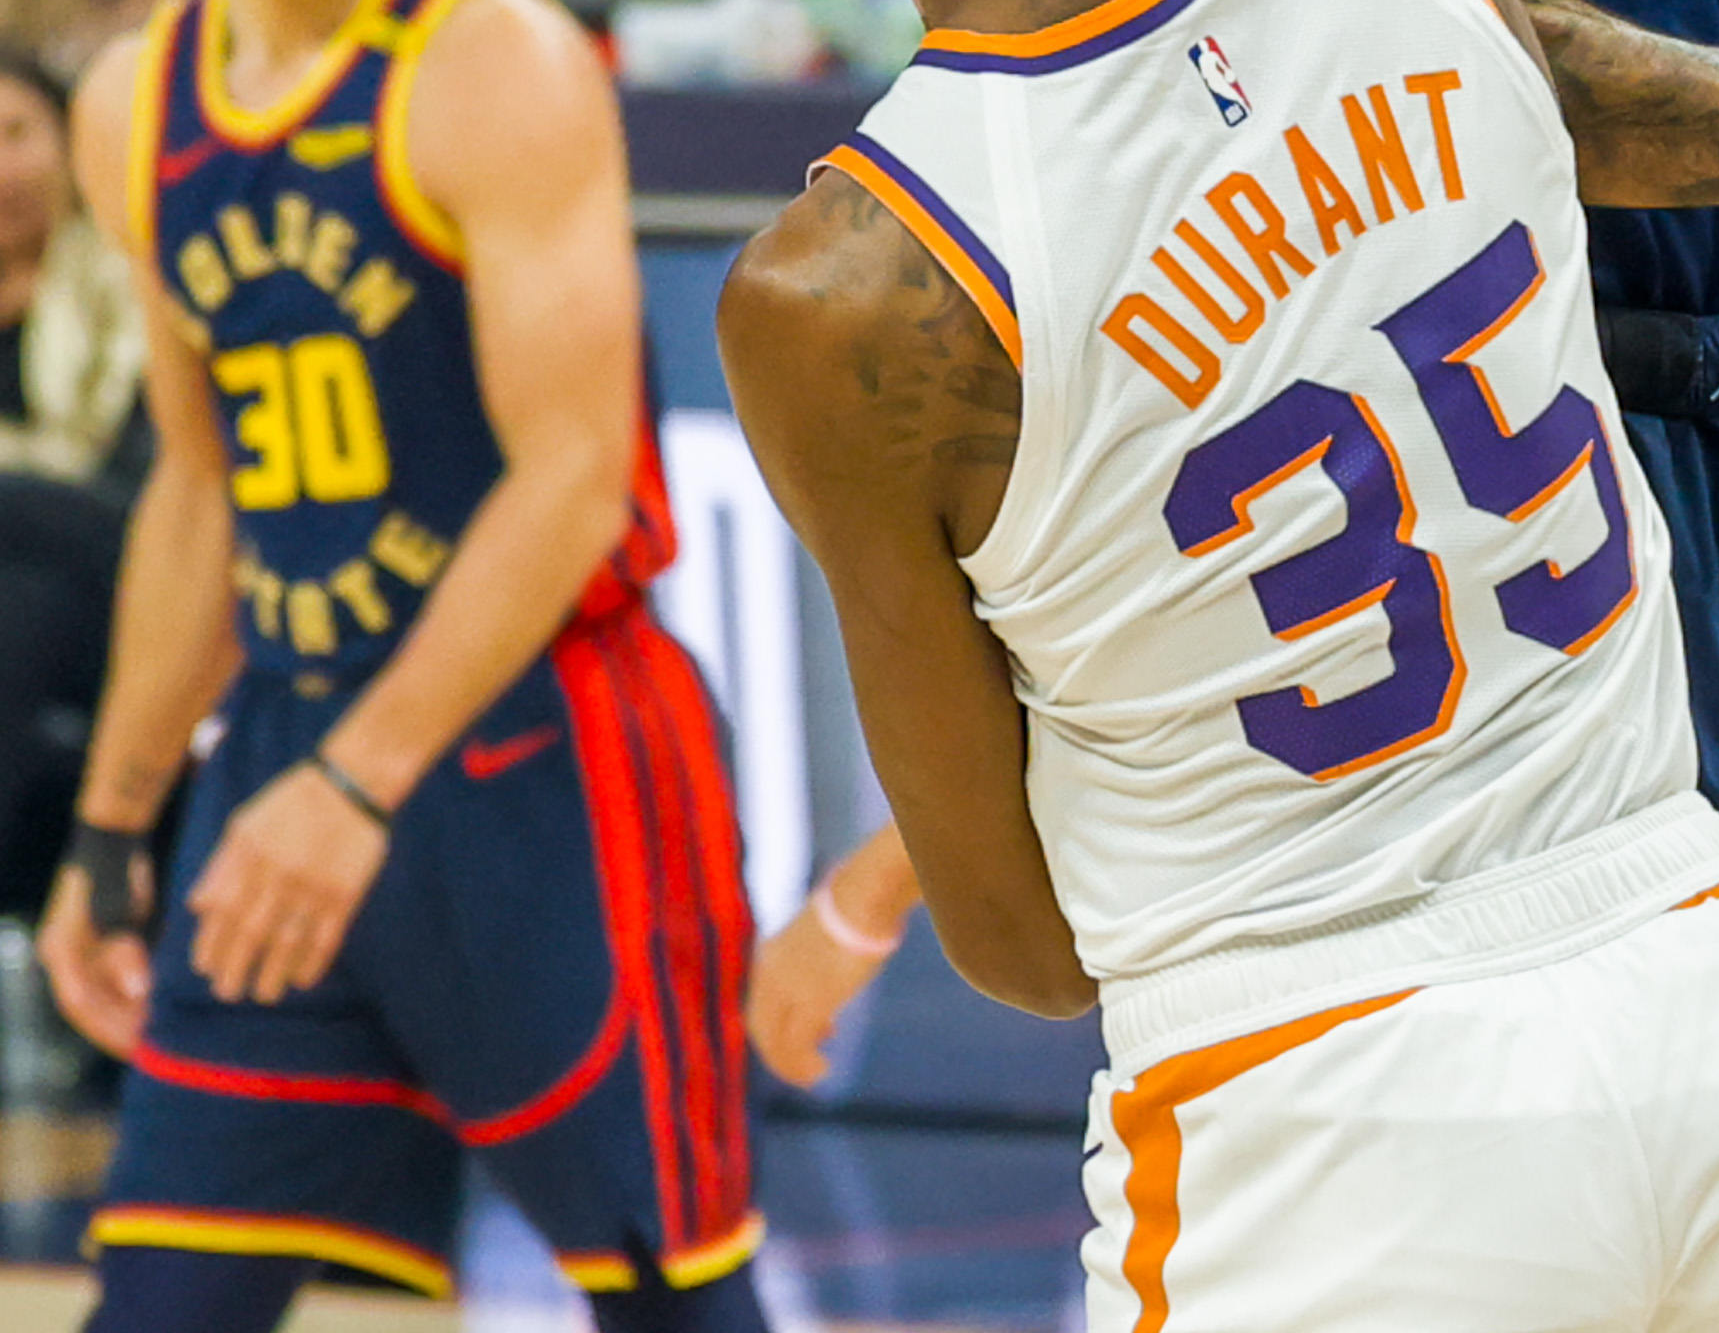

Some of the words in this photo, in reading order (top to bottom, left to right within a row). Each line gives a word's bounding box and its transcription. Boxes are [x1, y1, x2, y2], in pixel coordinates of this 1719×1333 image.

[1100, 69, 1465, 412] DURANT
[212, 332, 391, 511] 30
[1162, 218, 1640, 784] 35
